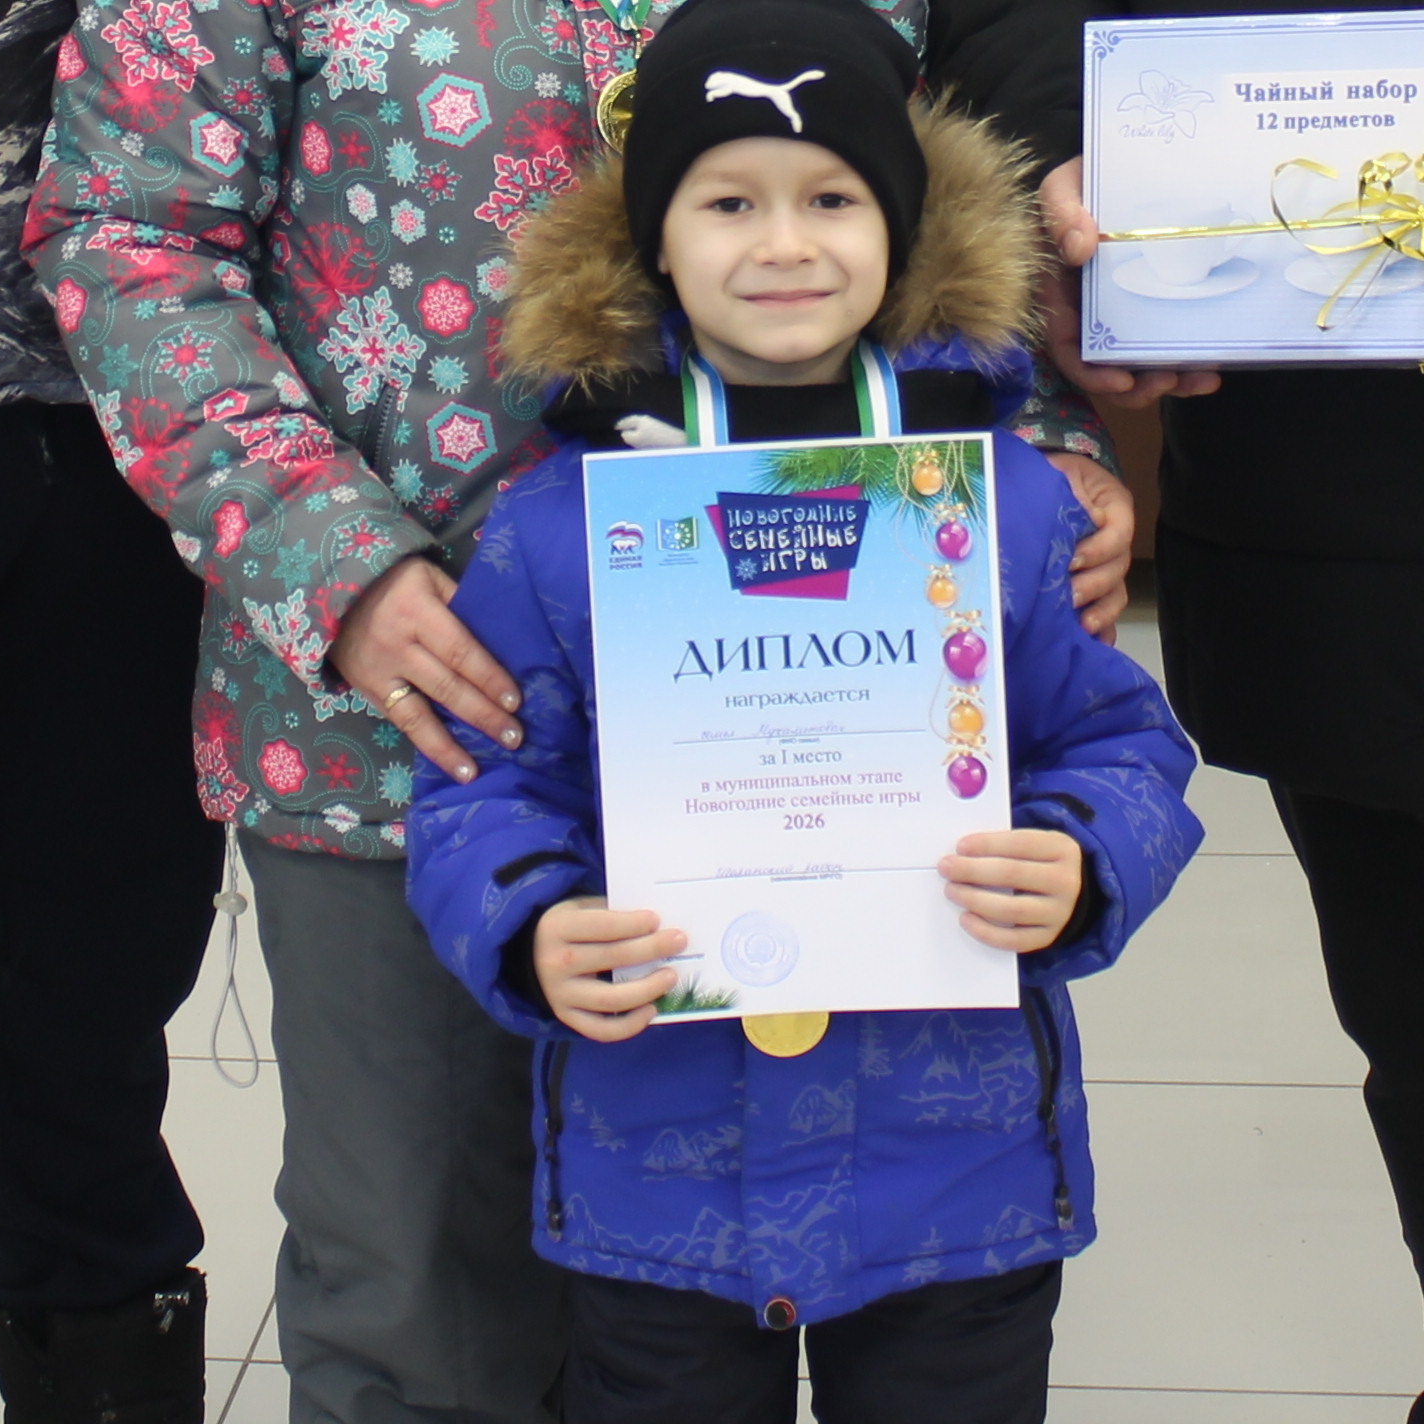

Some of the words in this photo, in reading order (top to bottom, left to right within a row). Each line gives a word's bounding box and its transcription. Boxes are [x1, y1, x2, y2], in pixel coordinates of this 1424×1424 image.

[1234, 81, 1334, 103] Чайный
[1346, 79, 1418, 103] набор
[1256, 112, 1278, 130] 12
[1283, 113, 1396, 134] предметов
[728, 524, 858, 551] СЕМЕЙНЫЕ
[760, 548, 828, 572] ИГРЫ
[673, 628, 918, 684] ДИПЛОМ
[725, 688, 870, 709] награждается
[759, 754, 776, 766] за
[793, 750, 842, 764] место
[701, 781, 710, 793] в
[715, 772, 852, 795] муниципальном
[857, 769, 903, 785] этапе
[684, 795, 785, 815] Новогодние
[790, 791, 874, 808] семейные
[879, 790, 921, 807] игры
[783, 813, 826, 830] 2026
